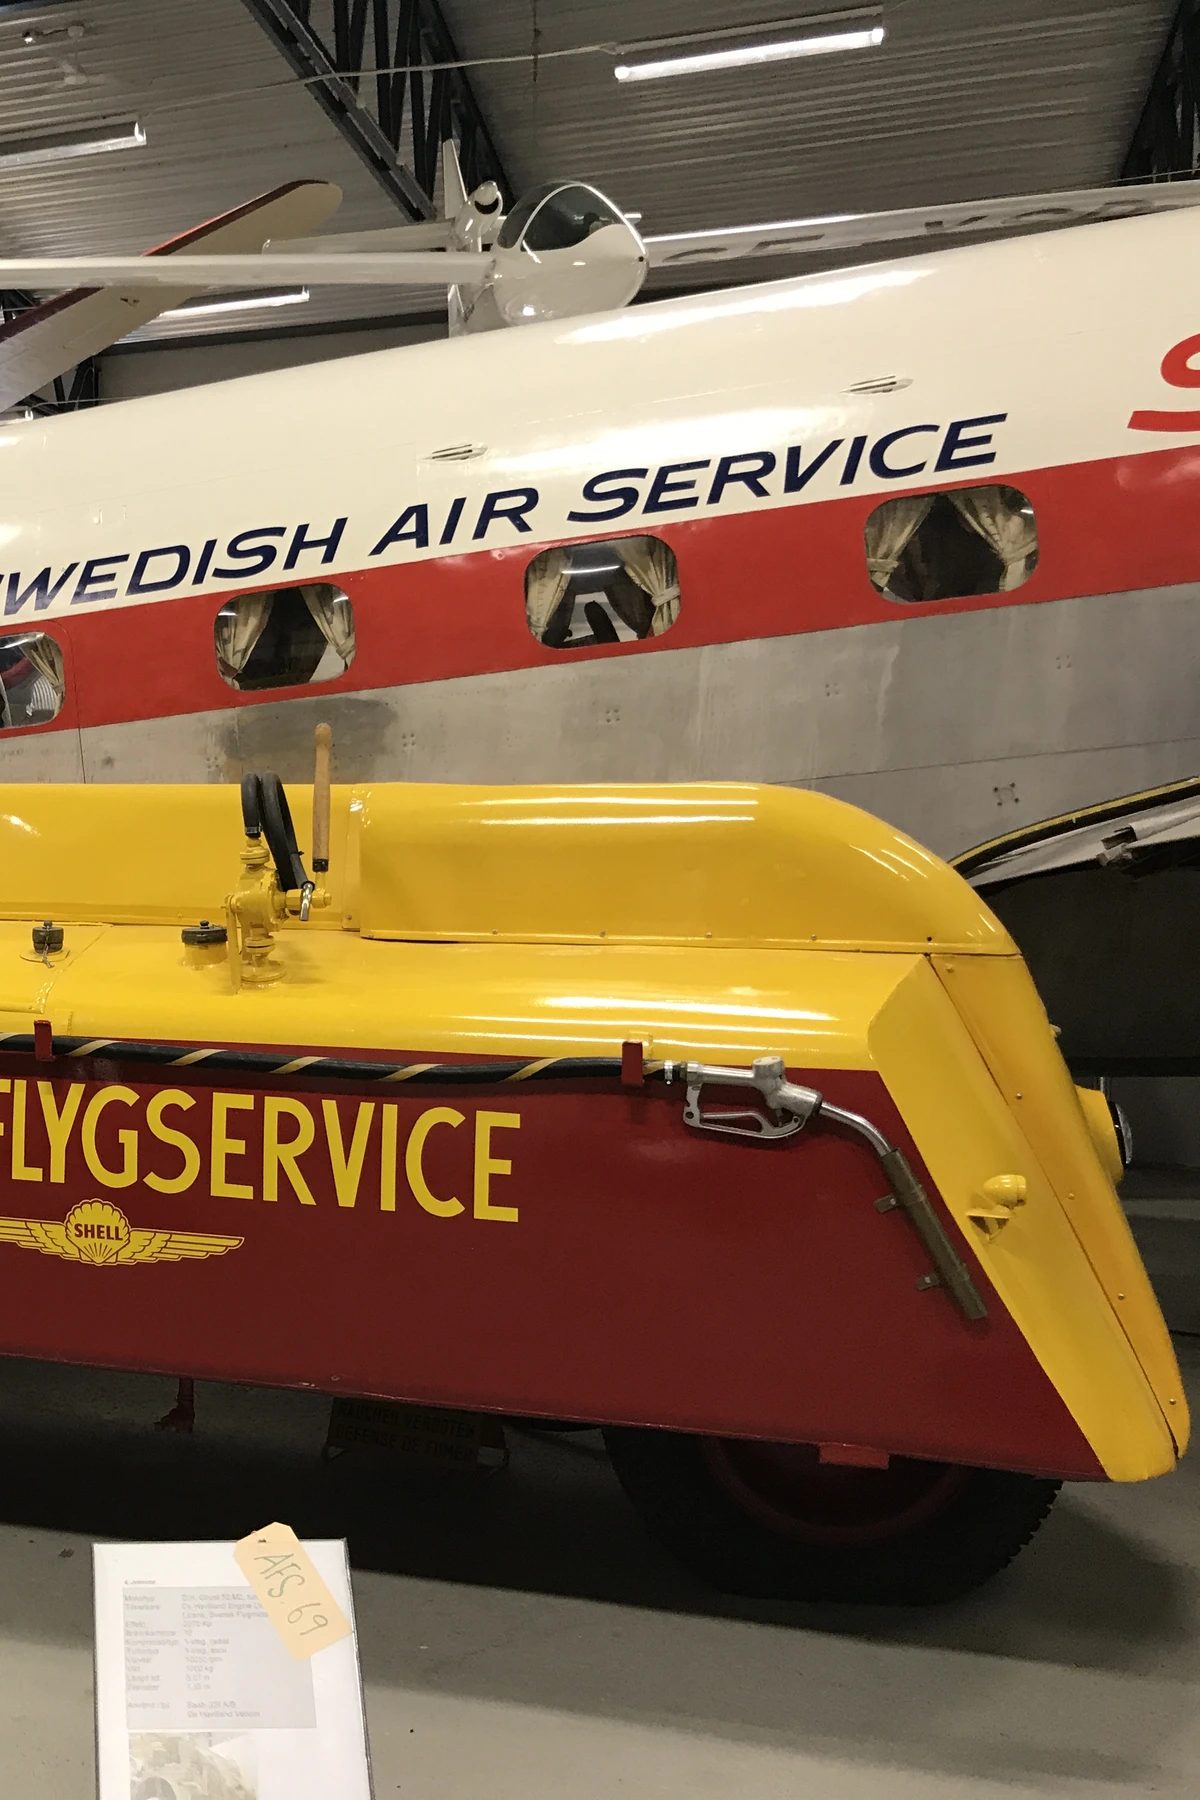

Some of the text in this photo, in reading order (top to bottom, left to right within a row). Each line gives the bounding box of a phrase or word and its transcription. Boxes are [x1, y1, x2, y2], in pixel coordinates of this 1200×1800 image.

[369, 487, 539, 558] AIR
[567, 412, 1008, 524] SERVICE
[74, 1223, 124, 1241] SHELL
[287, 1602, 329, 1637] 69
